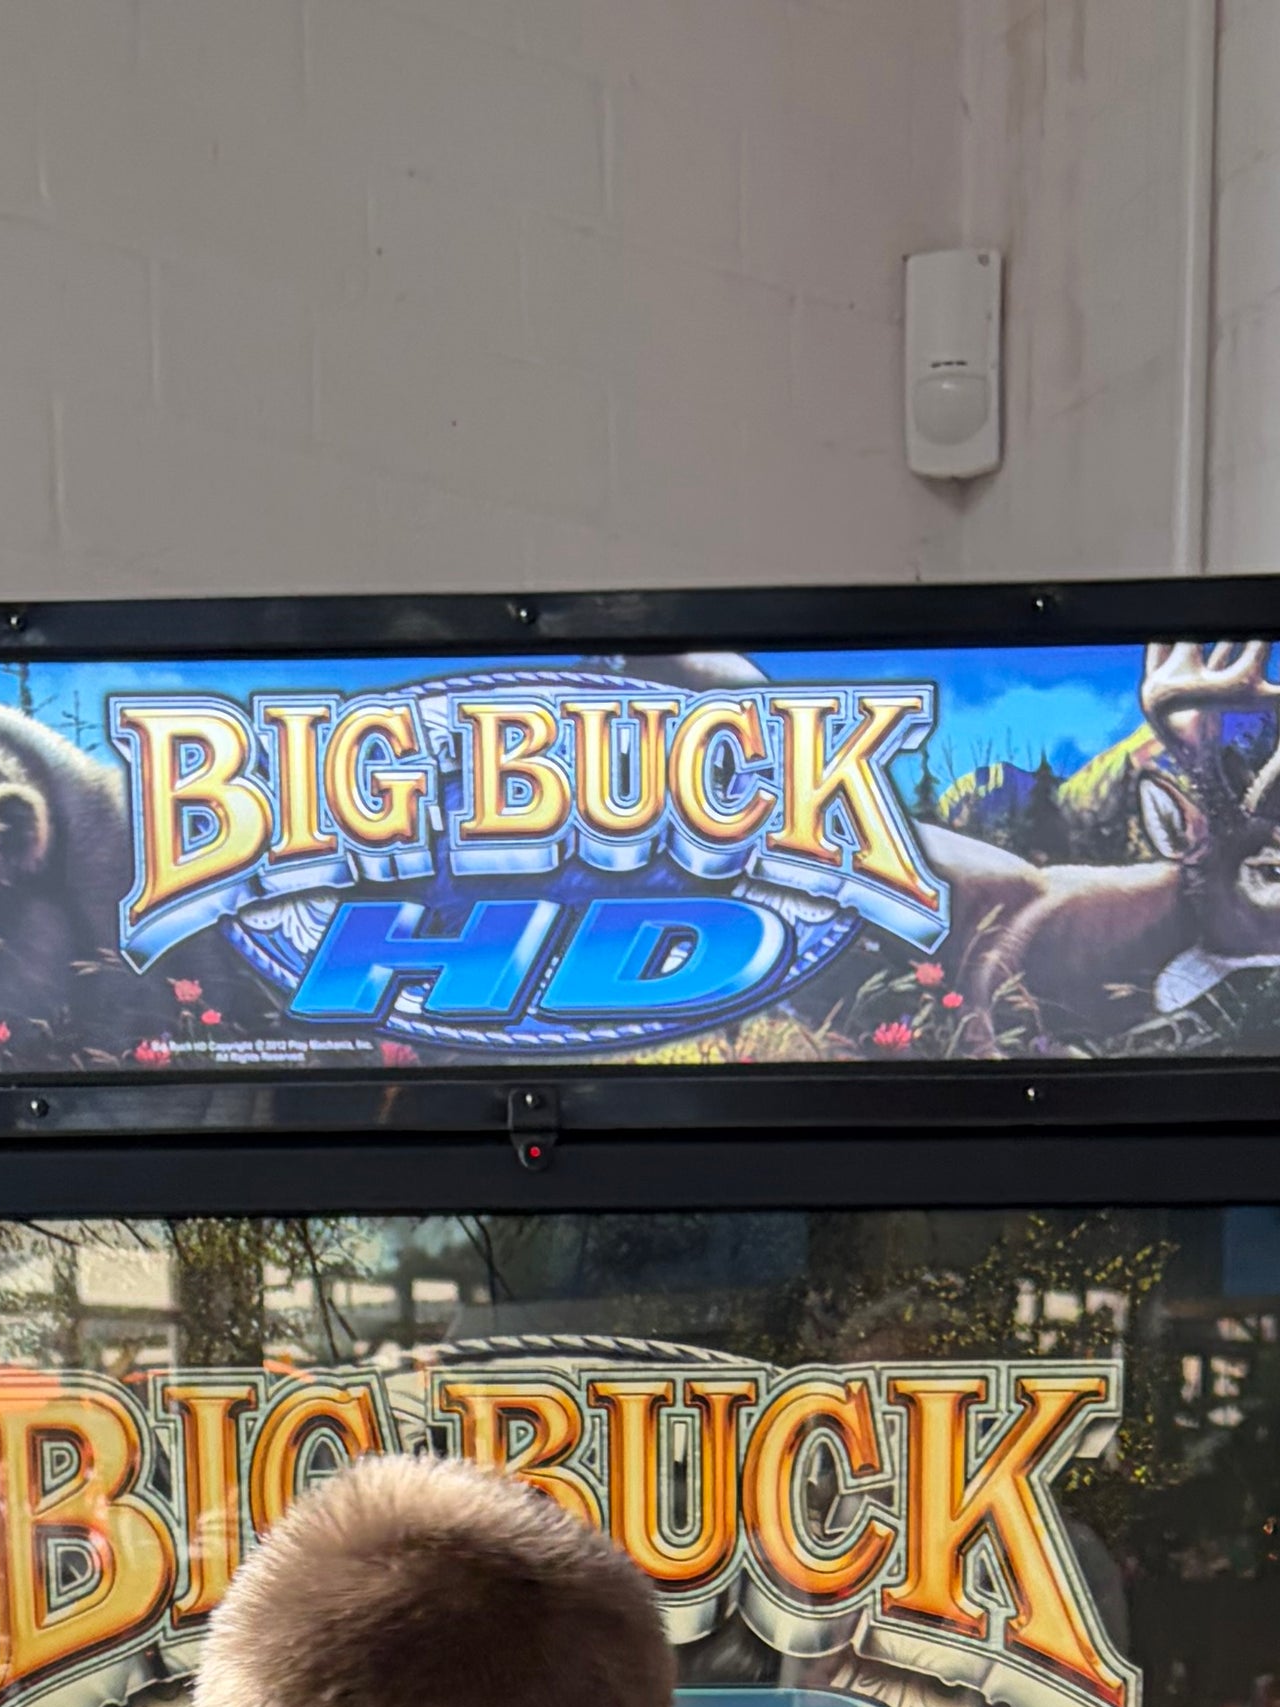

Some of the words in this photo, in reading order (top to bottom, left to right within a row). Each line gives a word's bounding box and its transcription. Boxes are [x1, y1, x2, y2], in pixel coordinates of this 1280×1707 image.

[114, 698, 436, 940] BIG
[450, 688, 948, 928] BUCK
[288, 896, 796, 1024] HD
